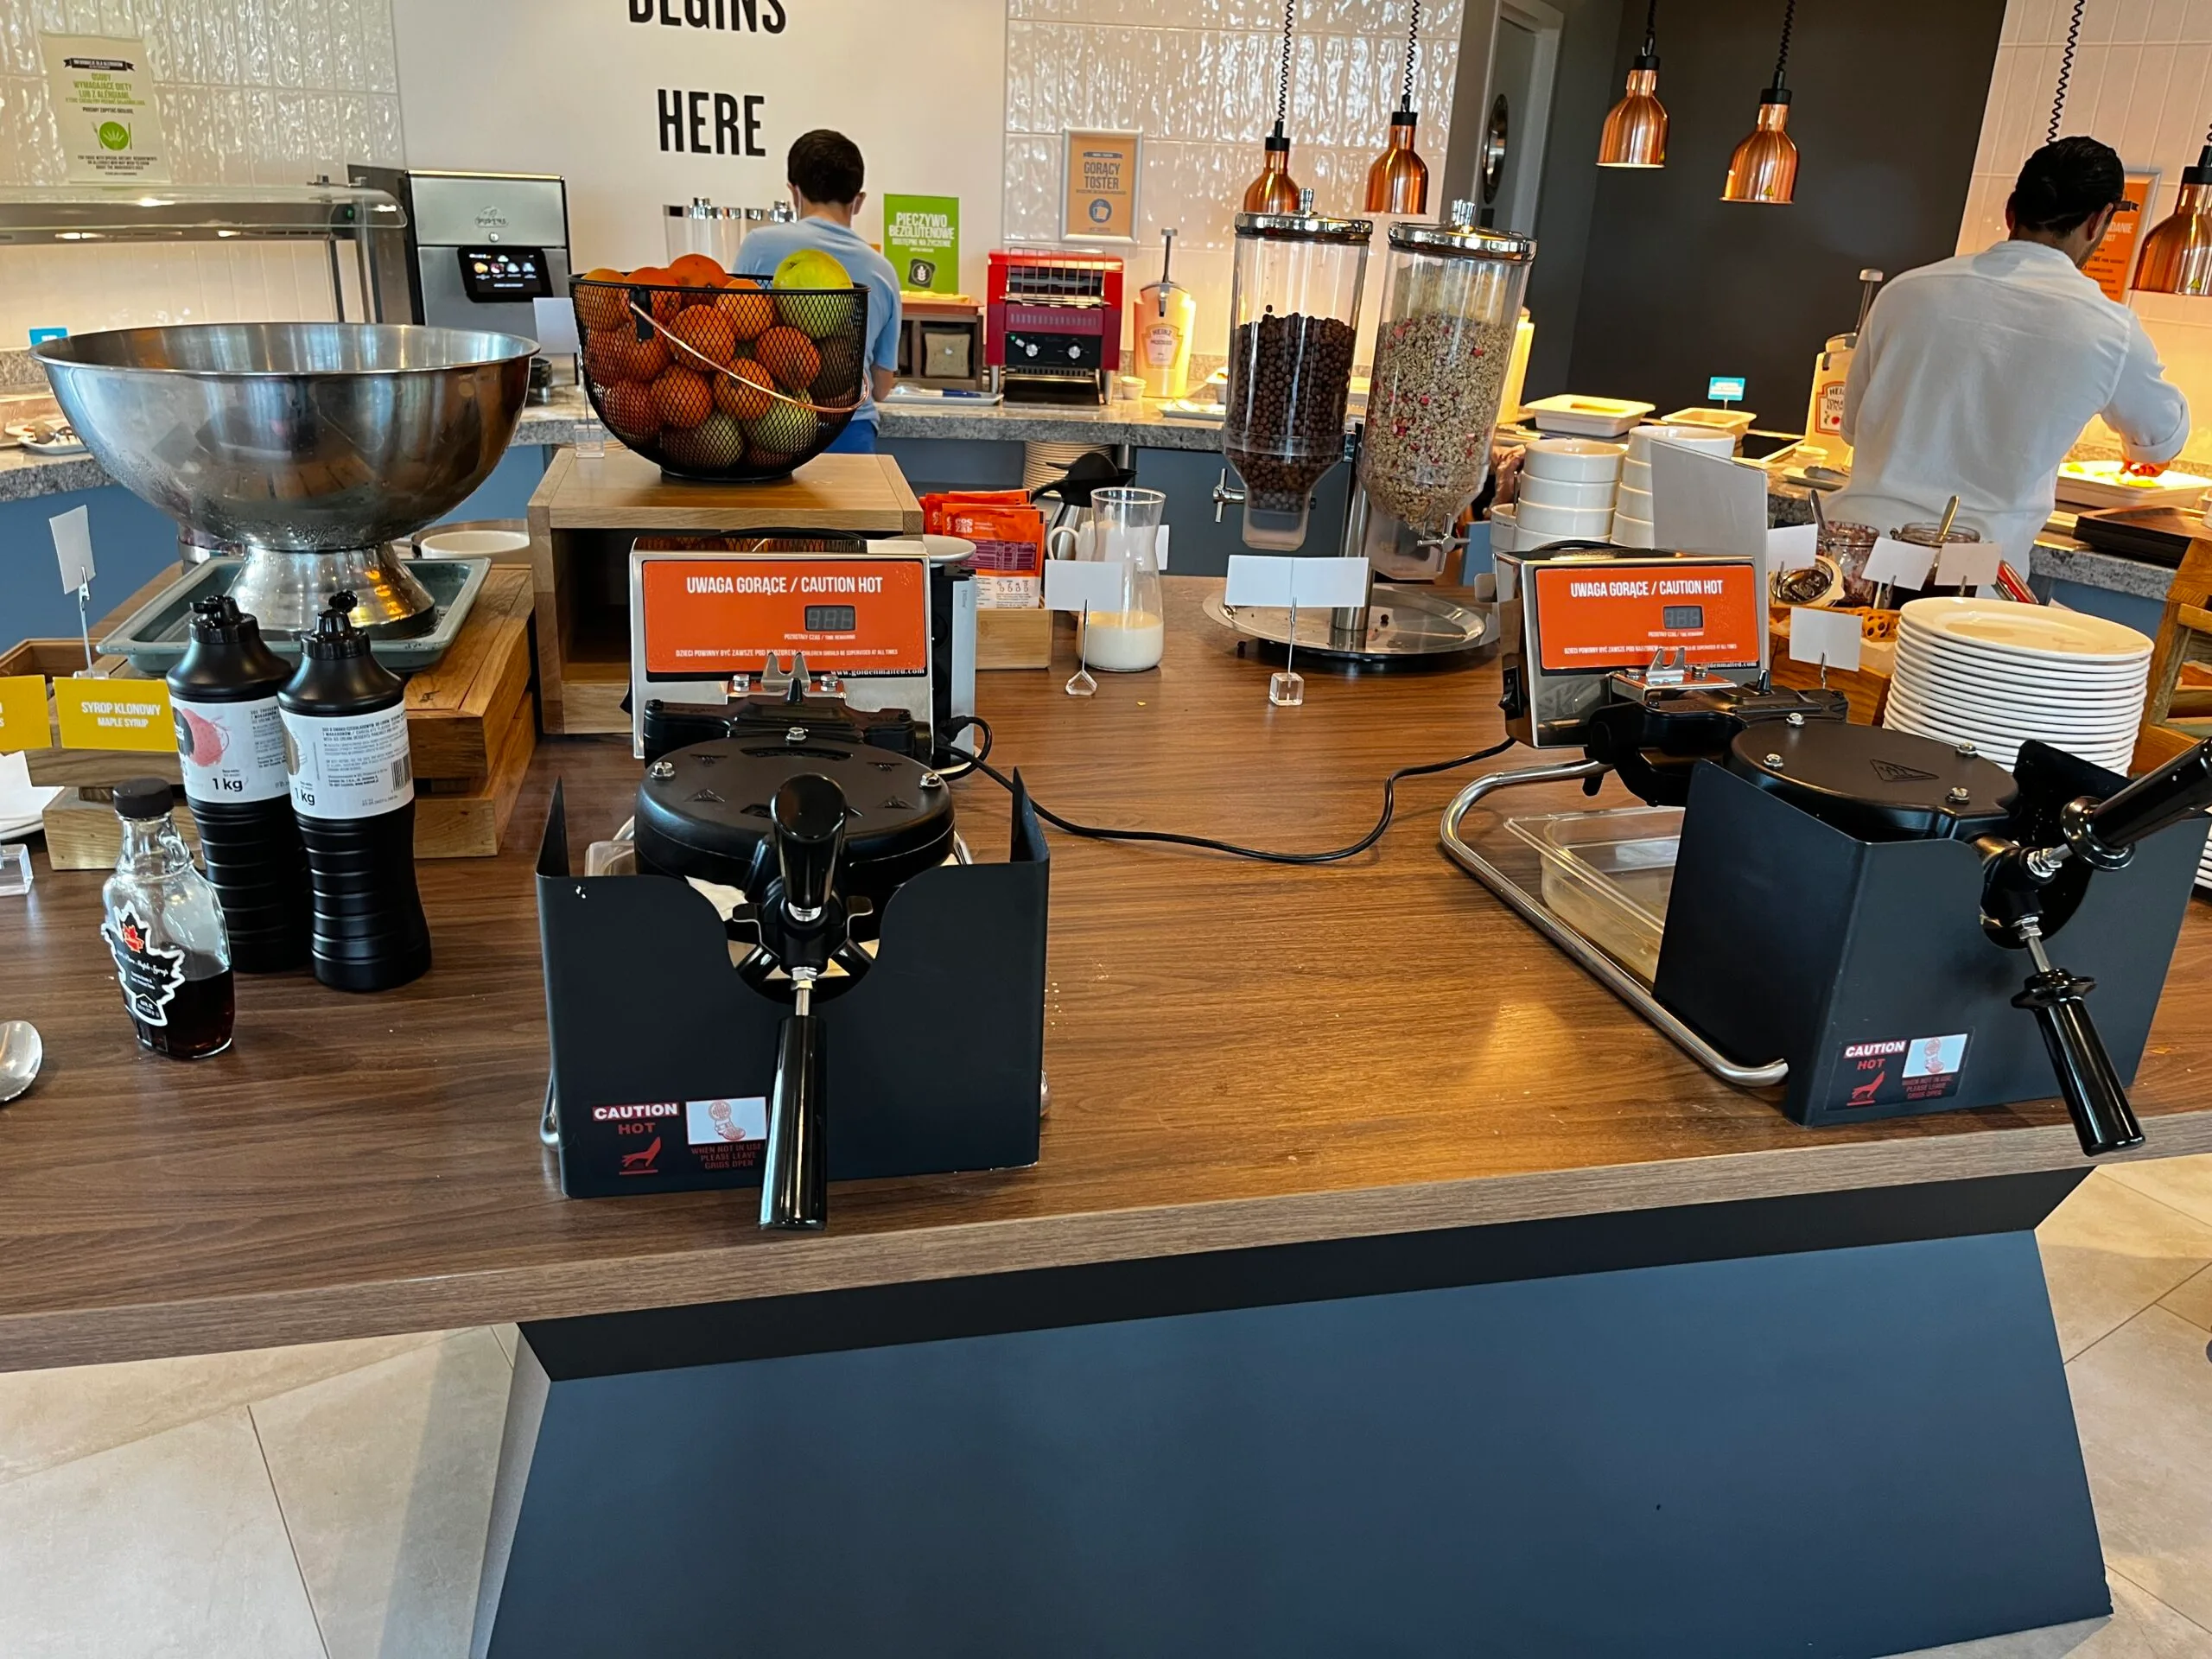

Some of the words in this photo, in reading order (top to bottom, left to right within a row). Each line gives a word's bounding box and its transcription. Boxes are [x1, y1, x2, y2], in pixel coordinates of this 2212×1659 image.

[658, 89, 766, 156] HERE
[1084, 175, 1119, 189] TOSTER
[896, 212, 948, 227] PIECZYWO
[888, 225, 955, 239] BEZGLUTENOWE
[687, 577, 734, 593] UWAGA
[736, 577, 787, 595] GORĄCE
[790, 577, 798, 594] /
[801, 576, 855, 593] CAUTION
[858, 576, 883, 593] HOT
[1570, 582, 1608, 597] UWAGA
[1609, 582, 1649, 598] GORĄCE
[1650, 581, 1657, 595] /
[1659, 581, 1702, 594] CAUTION
[1704, 580, 1724, 594] HOT
[81, 702, 113, 715] SYROP
[114, 702, 162, 715] KLONOWY
[98, 717, 123, 727] MAPLE
[124, 718, 149, 728] SYRUP
[212, 778, 219, 790] 1
[223, 778, 243, 792] kg
[295, 787, 299, 799] 1
[301, 789, 315, 806] kg
[1845, 1040, 1906, 1058] CAUTION
[1858, 1058, 1885, 1071] HOT
[594, 1103, 678, 1120] CAUTION
[618, 1122, 656, 1135] HOT
[691, 1146, 715, 1155] WHEN
[717, 1145, 734, 1154] NOT
[701, 1154, 730, 1162] PLEASE
